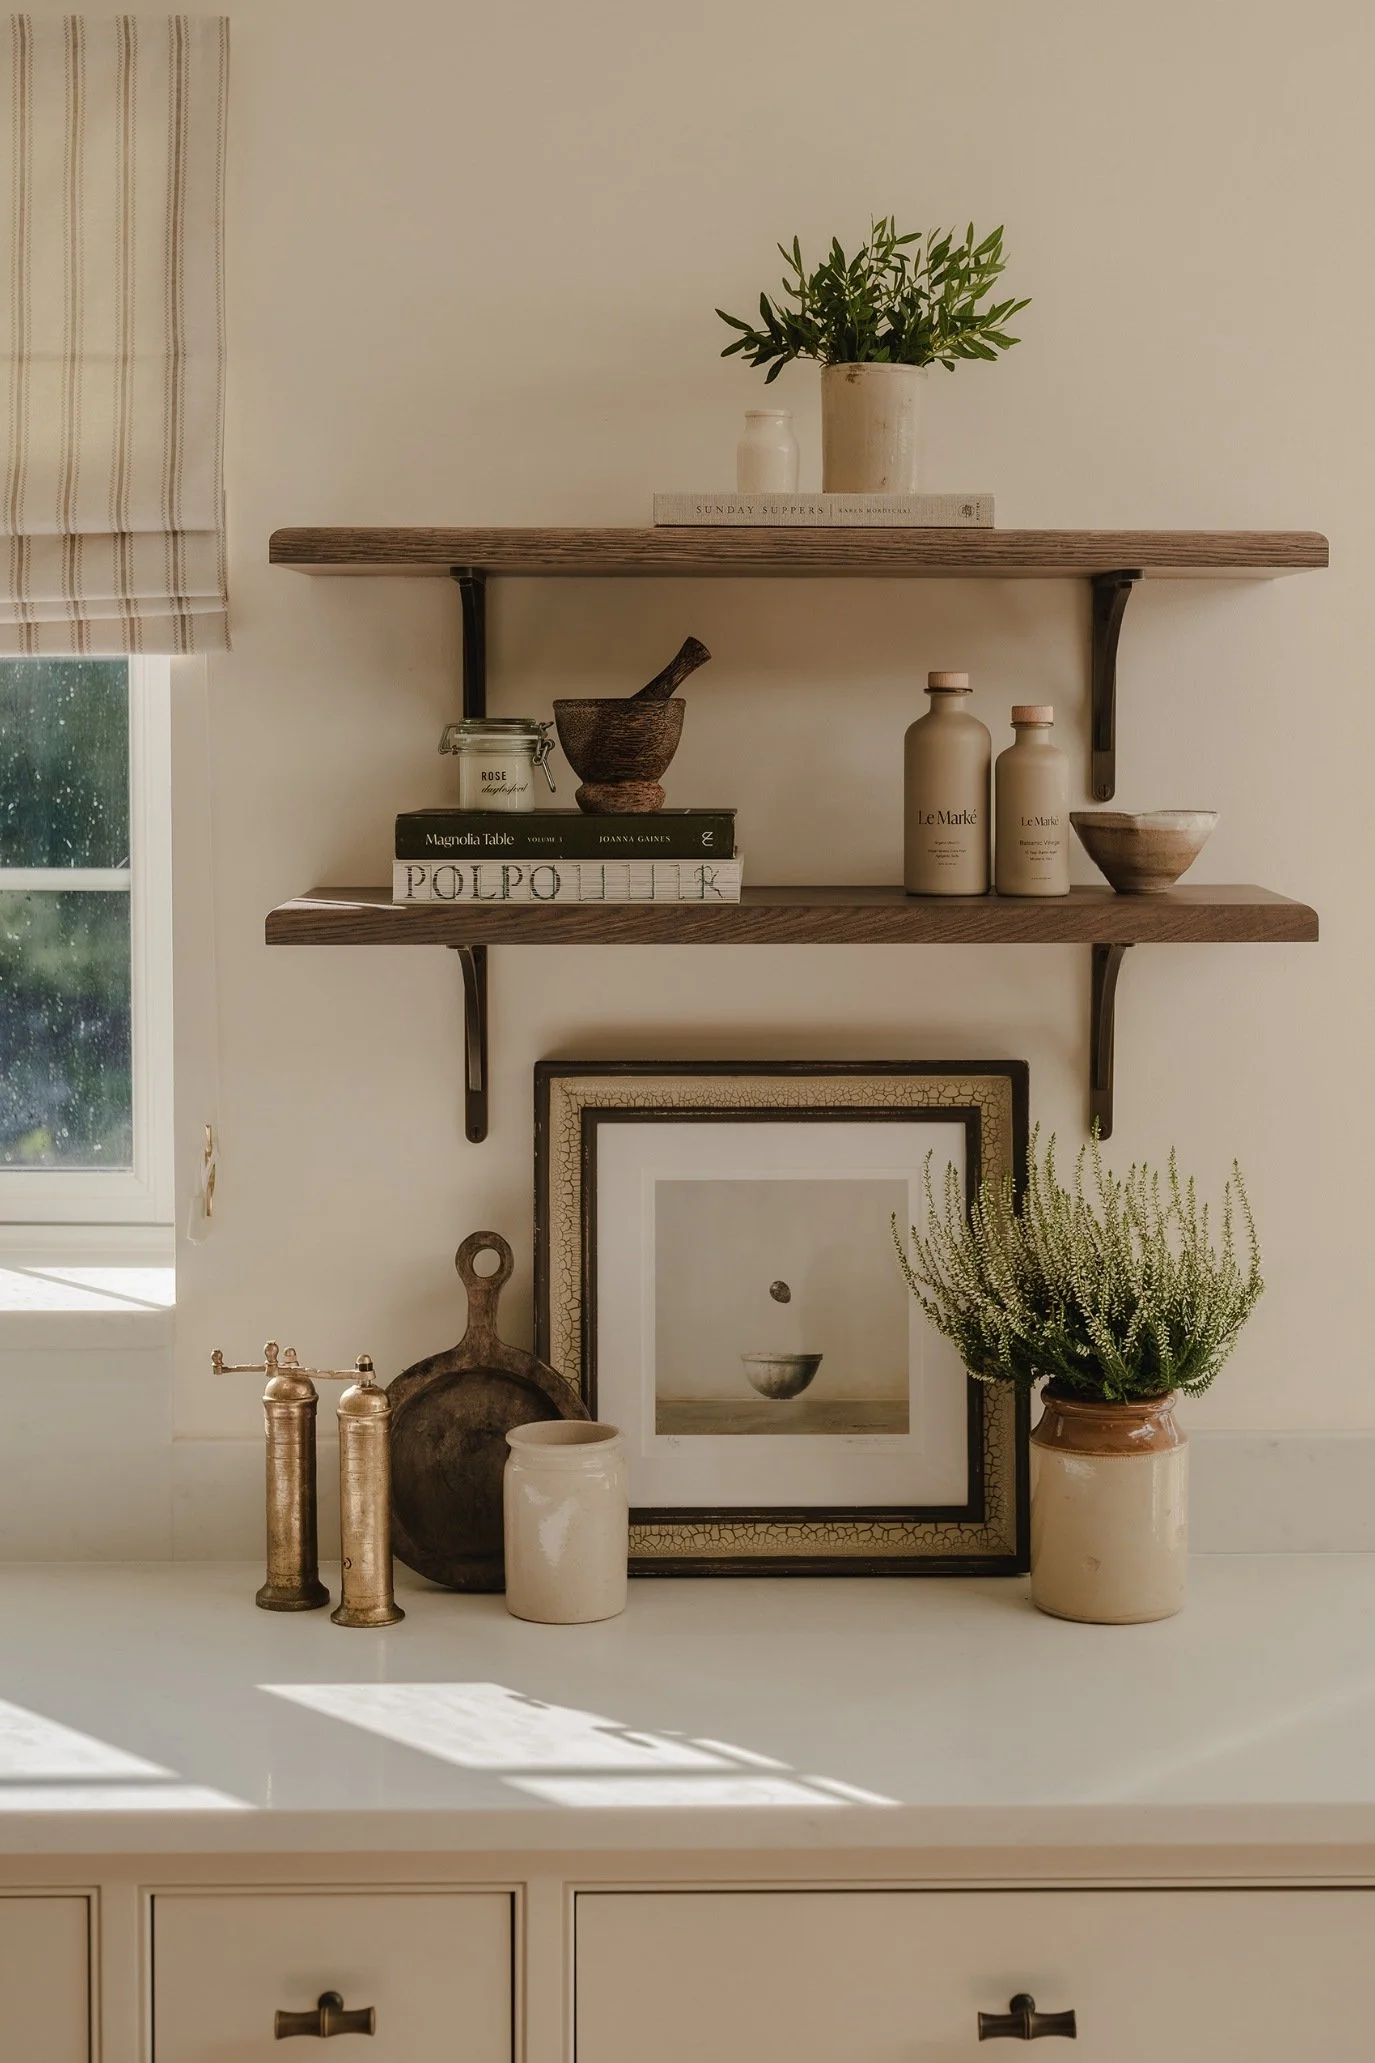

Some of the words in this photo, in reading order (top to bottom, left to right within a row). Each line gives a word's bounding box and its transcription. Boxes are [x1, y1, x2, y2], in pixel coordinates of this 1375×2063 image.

[696, 505, 754, 514] SUNDAY
[762, 505, 824, 515] SUPPERS
[481, 771, 507, 781] ROSE
[918, 809, 935, 825] Le
[937, 808, 977, 825] Marké
[1021, 816, 1033, 827] Le
[425, 833, 480, 848] Magnolia
[482, 833, 515, 846] Table
[599, 835, 635, 843] JOANNA
[637, 835, 671, 843] GAINES
[404, 865, 562, 900] POLPO
